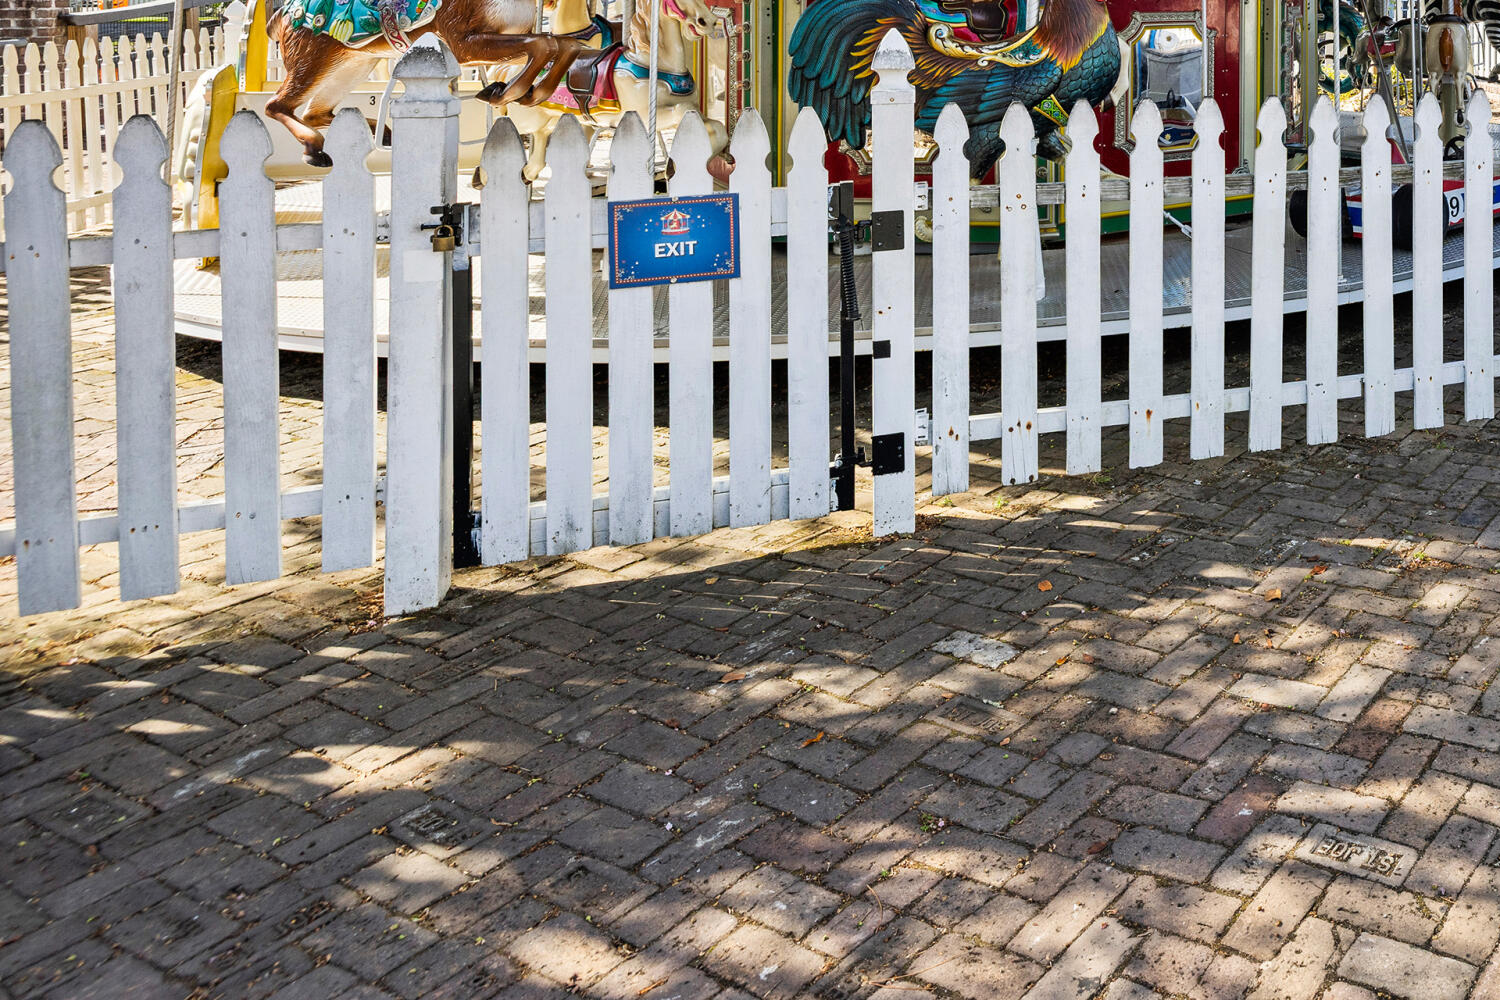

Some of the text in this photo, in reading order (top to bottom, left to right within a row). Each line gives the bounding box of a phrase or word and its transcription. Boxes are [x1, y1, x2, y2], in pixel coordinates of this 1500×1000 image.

[370, 96, 376, 106] 3
[1450, 196, 1460, 218] 9
[654, 240, 698, 258] EXIT
[1316, 837, 1362, 862] JOE
